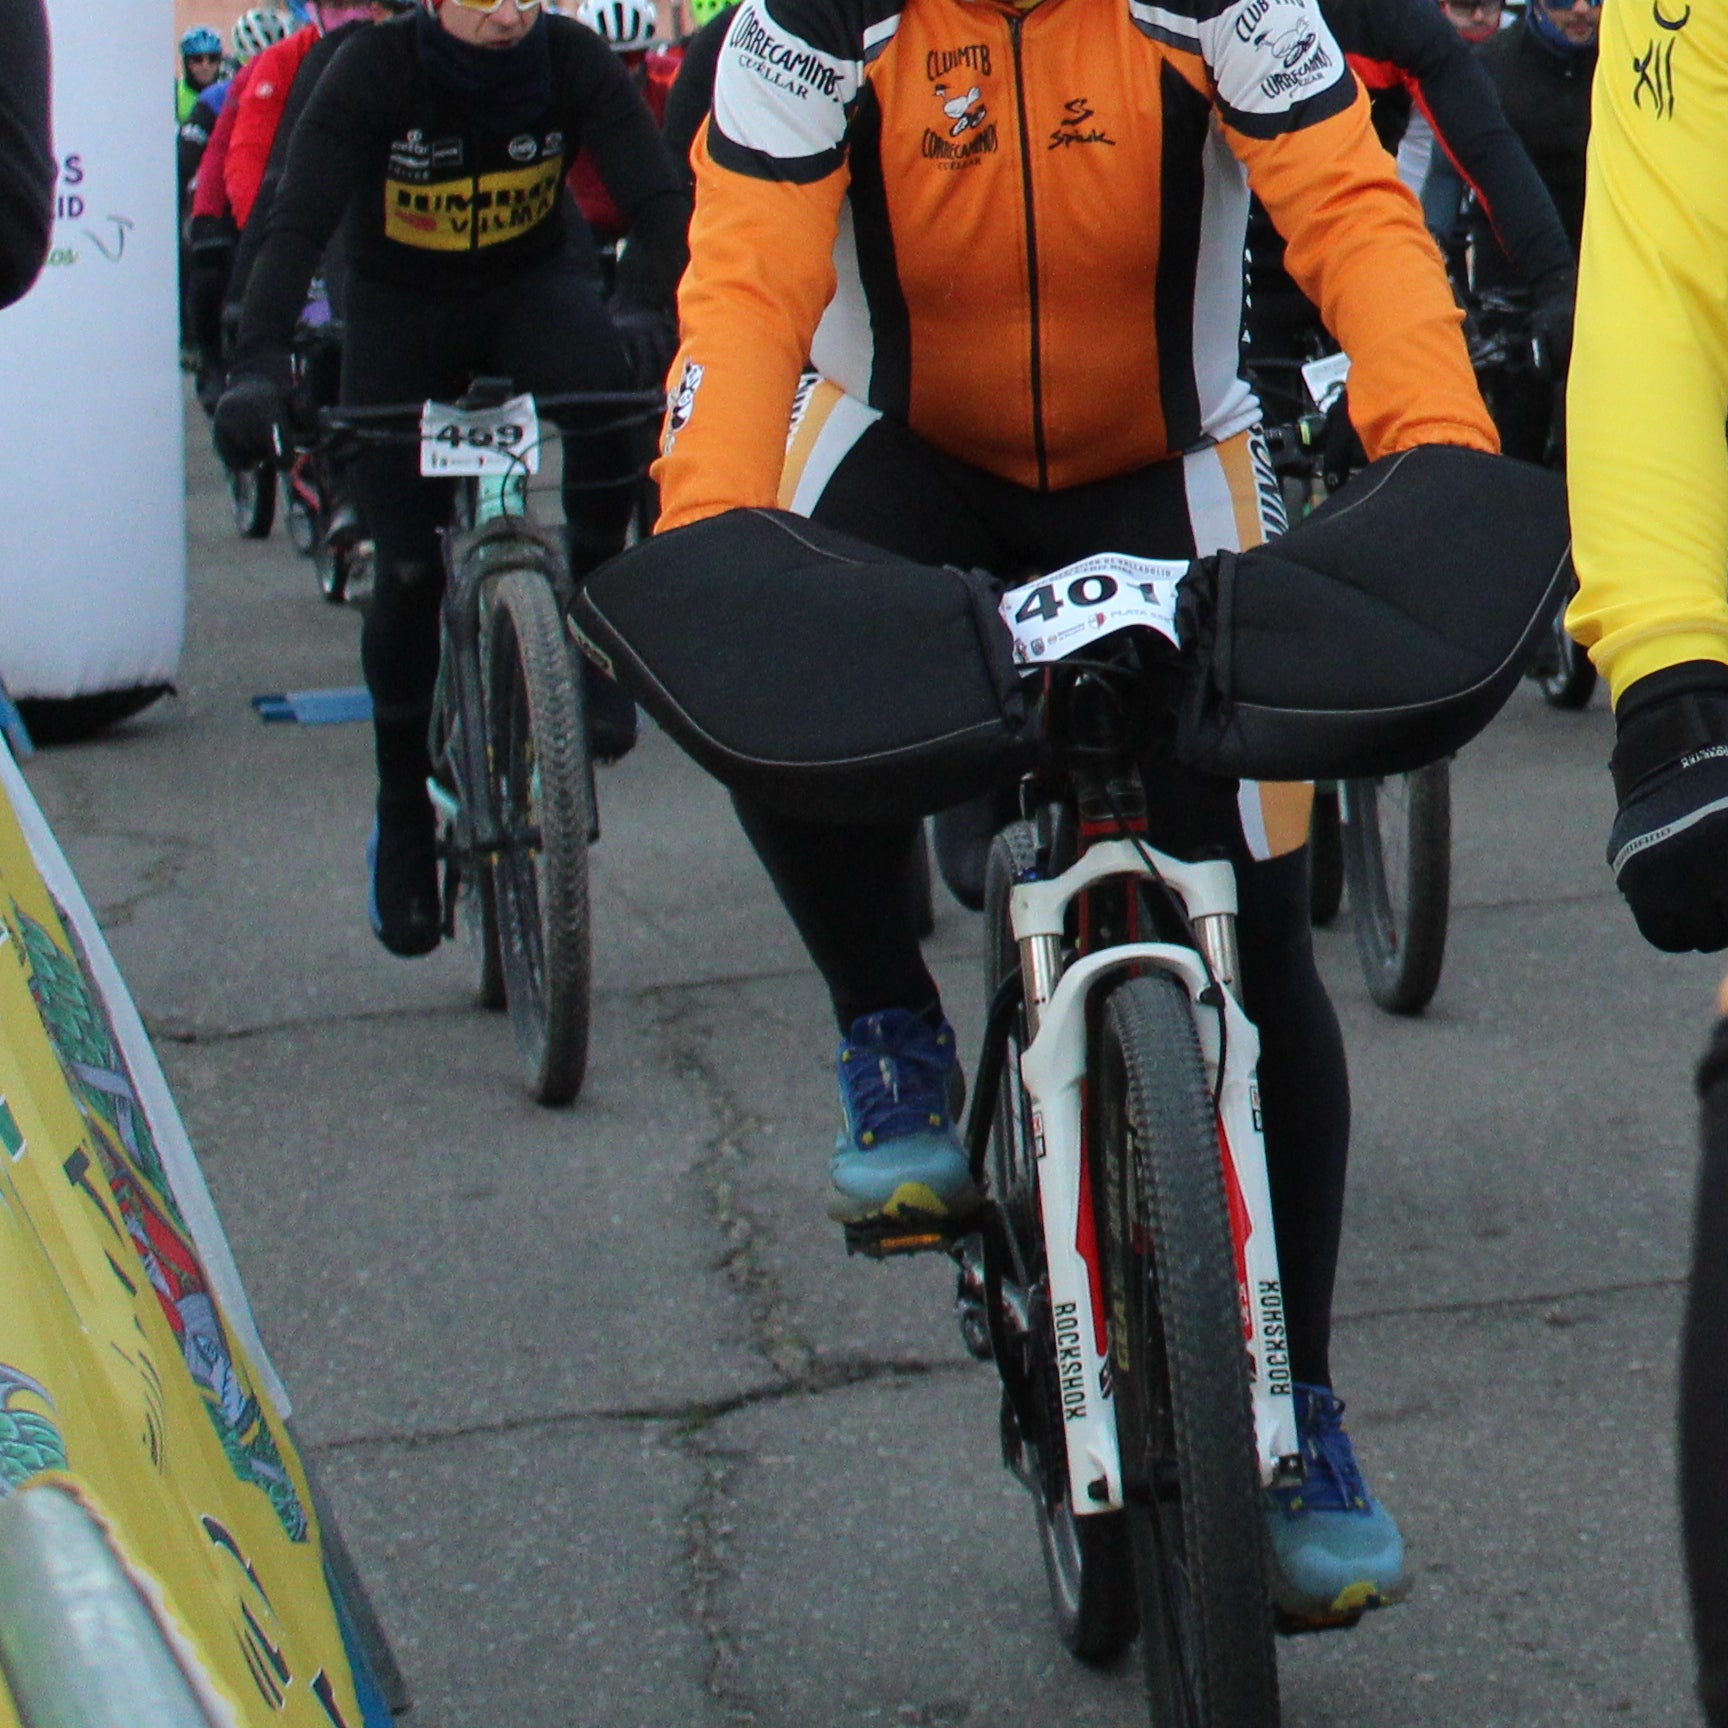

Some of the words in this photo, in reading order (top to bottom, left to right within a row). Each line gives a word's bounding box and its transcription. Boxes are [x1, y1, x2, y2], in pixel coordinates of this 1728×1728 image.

[1015, 574, 1161, 624] 401
[1054, 1301, 1088, 1421] ROCKSHOX
[1258, 1279, 1292, 1397] ROCKSHOX
